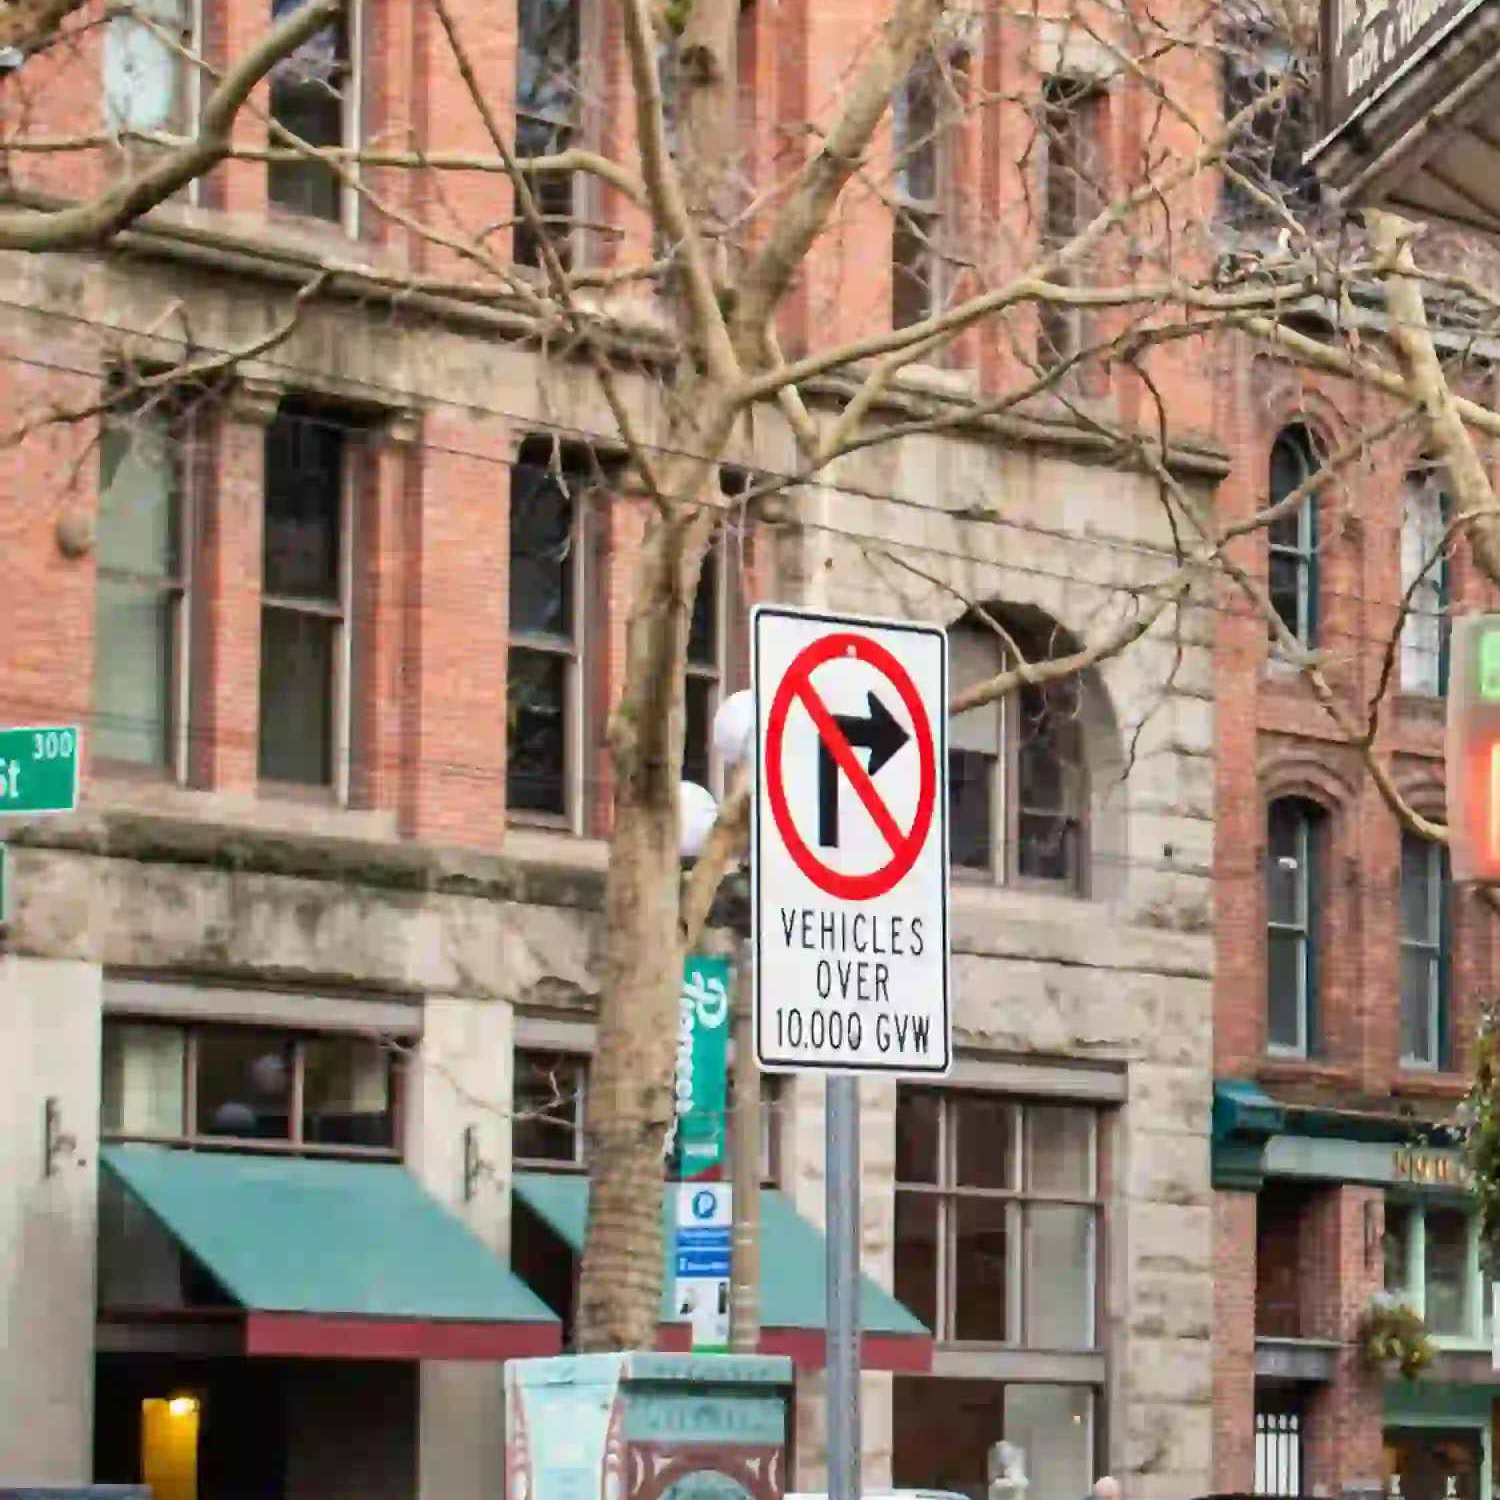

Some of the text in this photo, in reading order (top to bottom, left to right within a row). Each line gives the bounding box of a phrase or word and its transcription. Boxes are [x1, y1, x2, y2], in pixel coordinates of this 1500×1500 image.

[32, 731, 72, 760] 300
[780, 907, 924, 956] VEHICLES
[816, 959, 889, 1003] OVER
[876, 1011, 930, 1054] GVW
